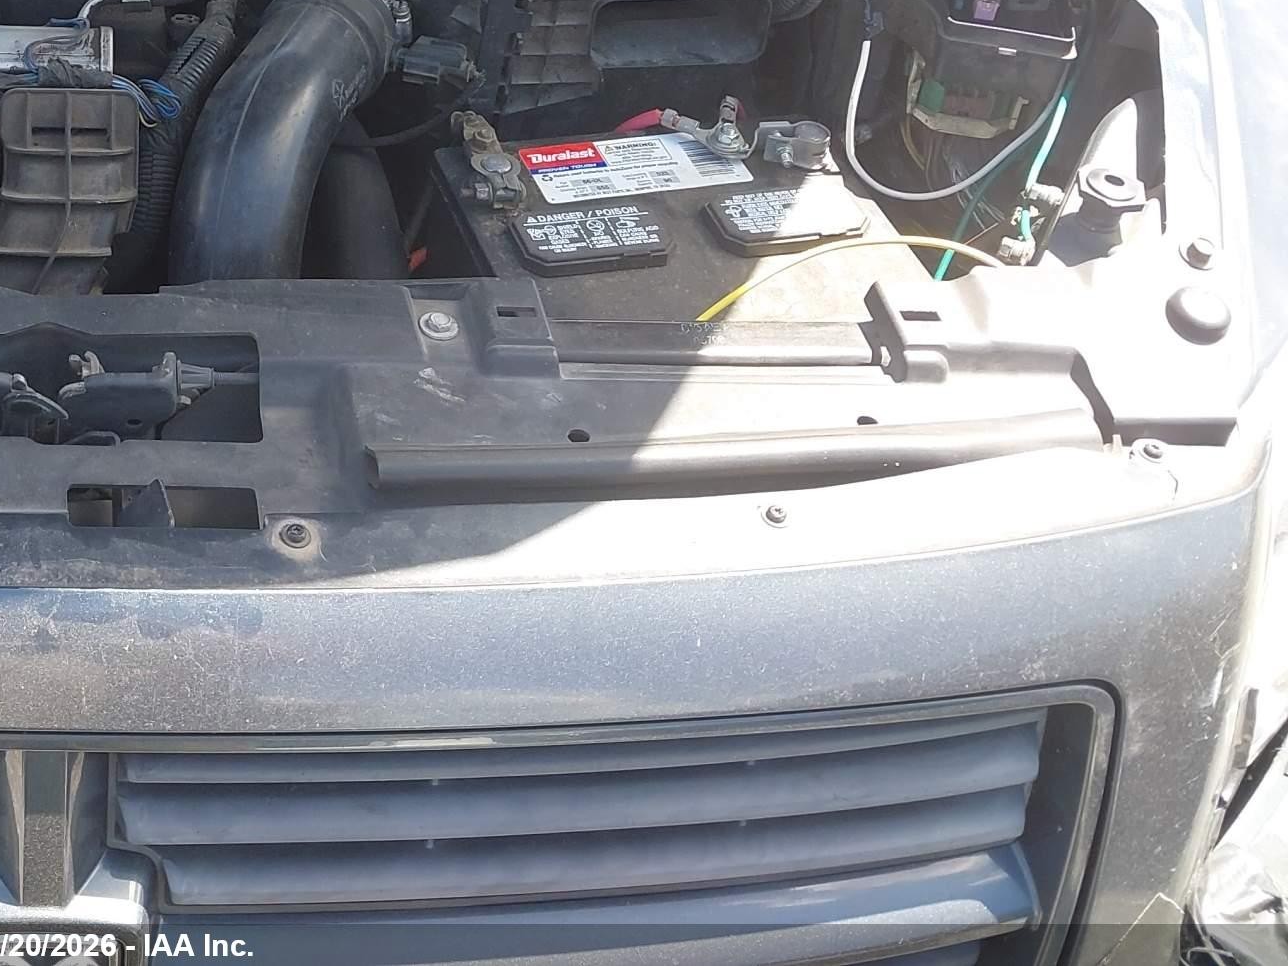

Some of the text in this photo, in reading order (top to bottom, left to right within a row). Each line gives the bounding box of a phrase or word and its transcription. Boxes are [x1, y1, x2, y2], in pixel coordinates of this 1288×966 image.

[527, 147, 596, 164] Duralast
[536, 211, 585, 223] DANGER
[594, 206, 639, 217] POISON
